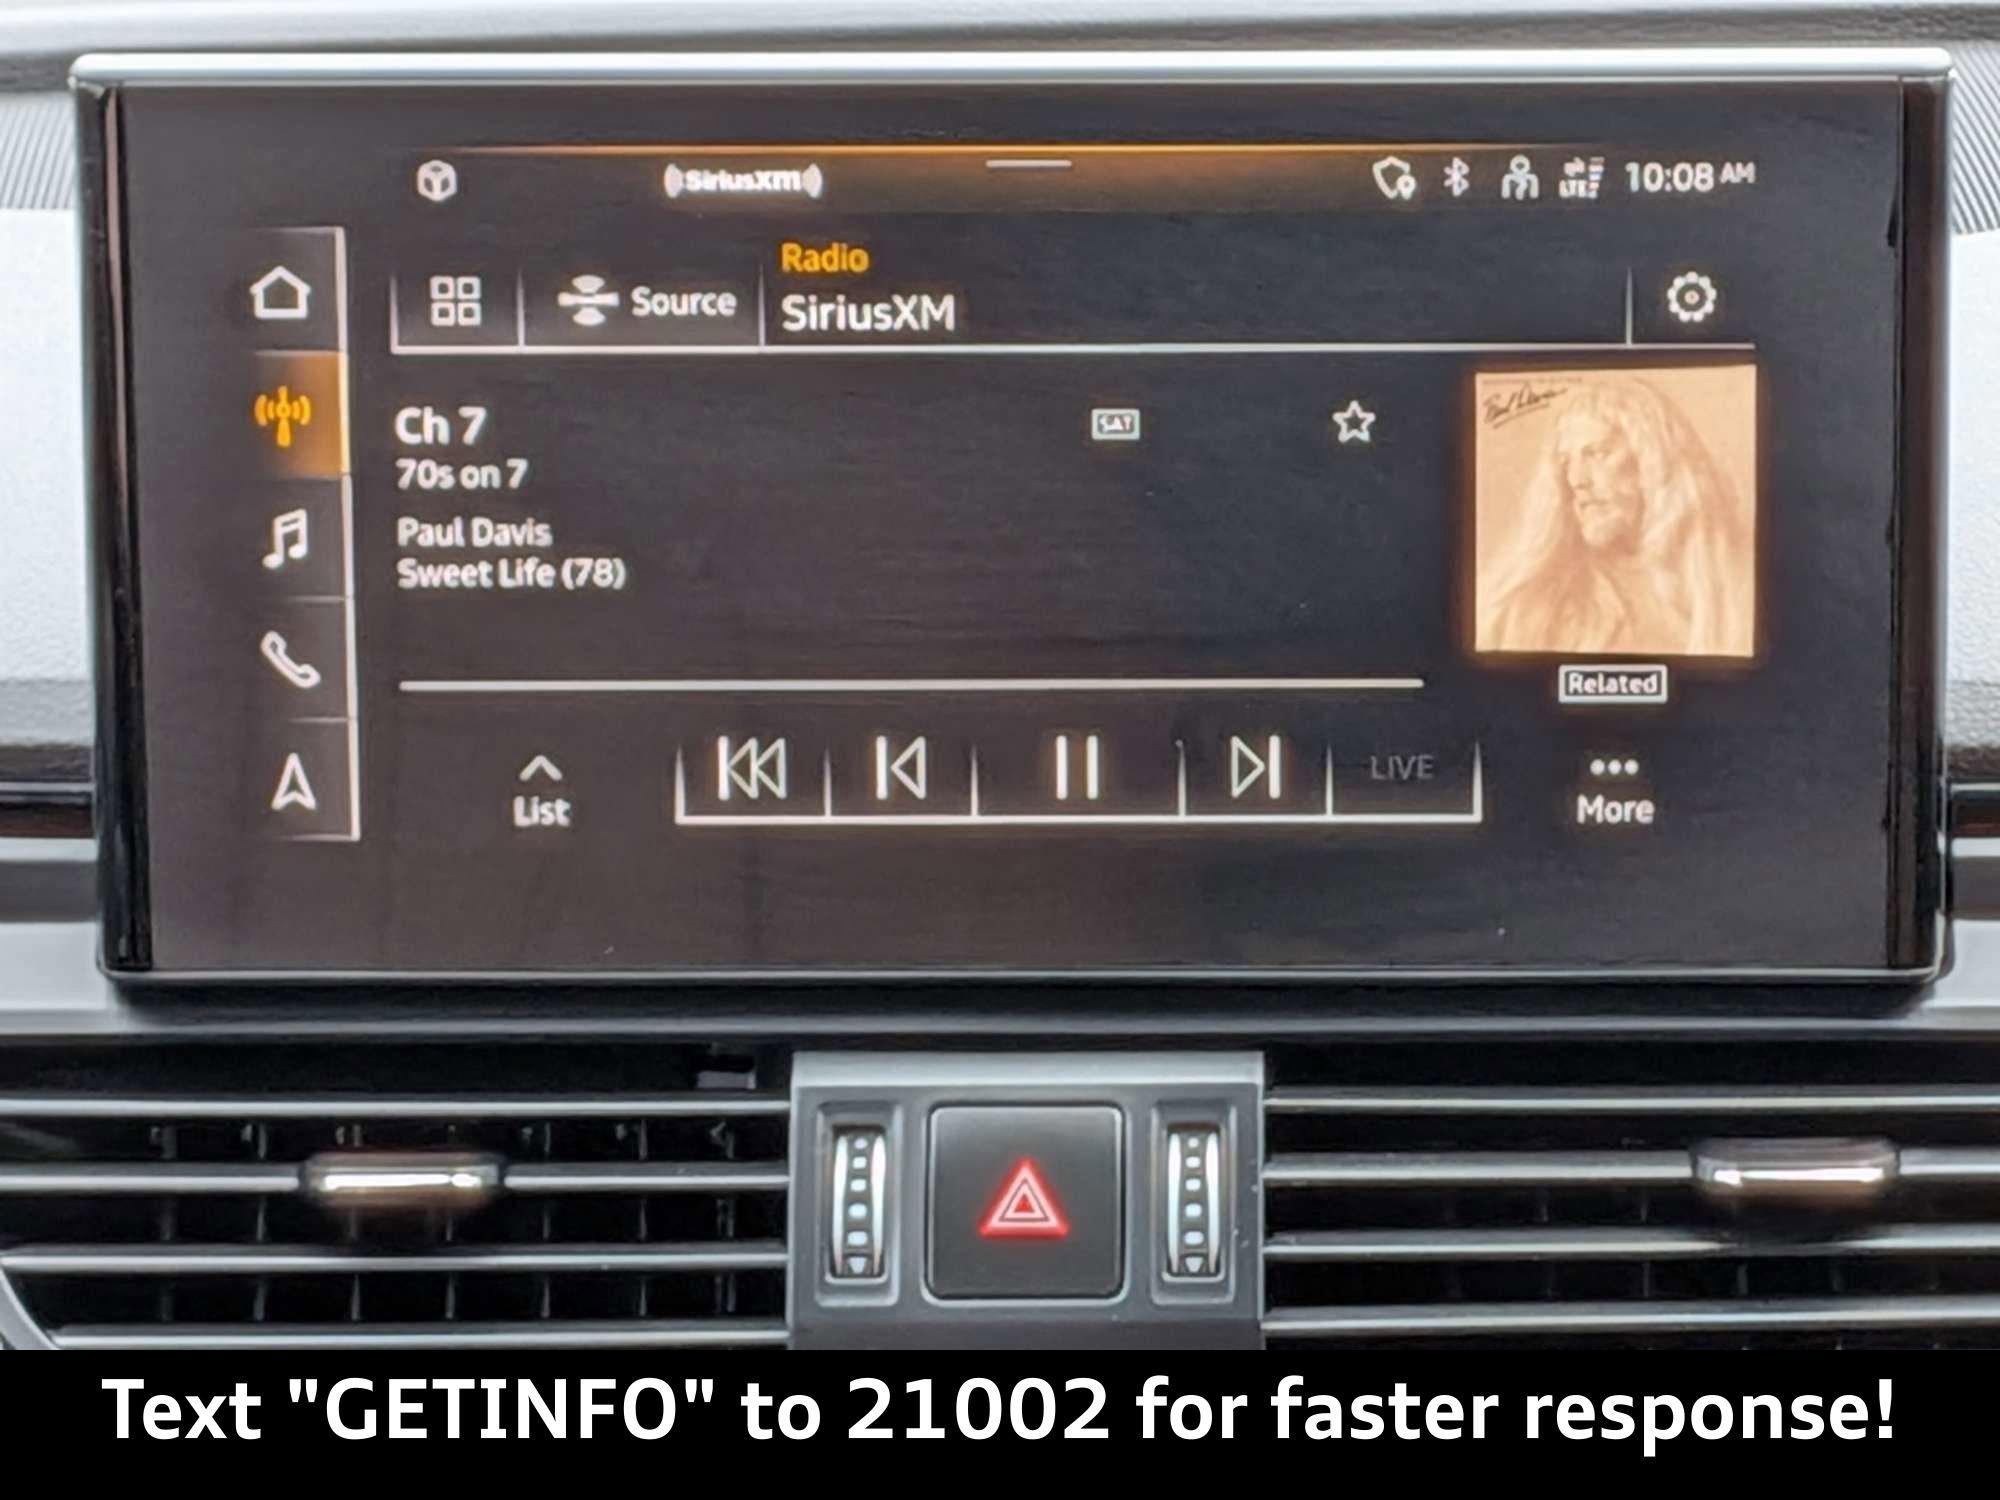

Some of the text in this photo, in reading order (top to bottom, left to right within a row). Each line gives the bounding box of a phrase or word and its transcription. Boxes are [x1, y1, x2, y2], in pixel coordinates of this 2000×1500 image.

[1625, 162, 1755, 192] 10:08 AM
[781, 242, 869, 273] Radio
[631, 286, 737, 317] Source
[781, 293, 955, 332] SiriusXM
[394, 406, 487, 445] Ch 7
[395, 458, 528, 490] 70s on 7
[397, 516, 553, 548] Paul Davis
[397, 556, 626, 590] Sweet Life (78)
[1568, 673, 1659, 694] Related
[1370, 754, 1433, 780] LIVE
[513, 796, 571, 827] List
[1576, 794, 1655, 824] More
